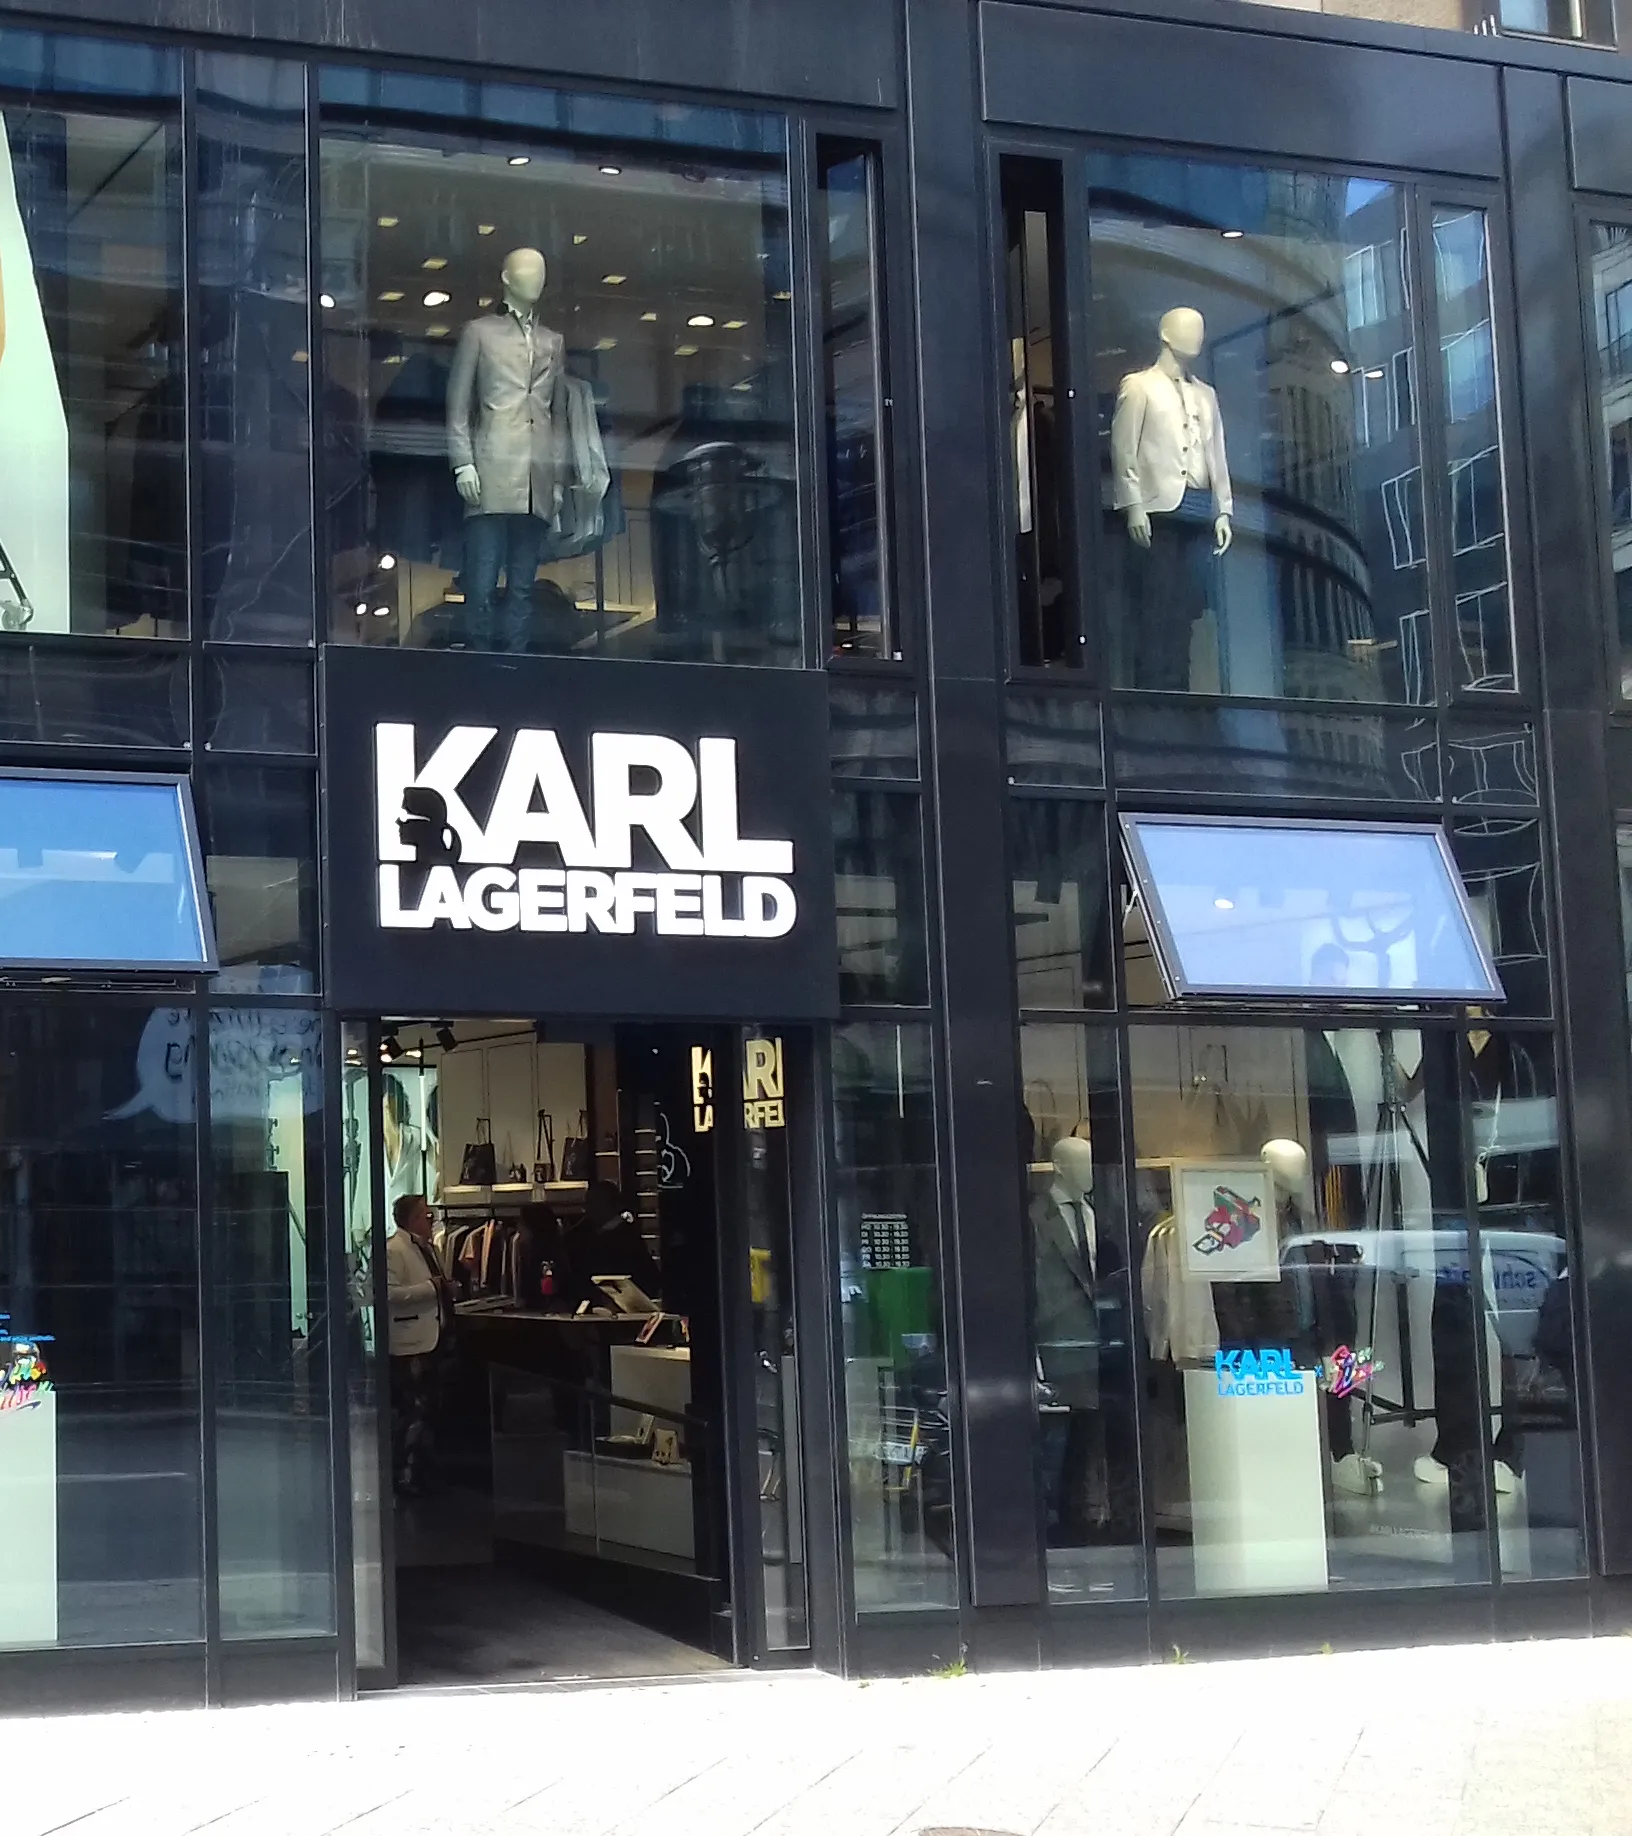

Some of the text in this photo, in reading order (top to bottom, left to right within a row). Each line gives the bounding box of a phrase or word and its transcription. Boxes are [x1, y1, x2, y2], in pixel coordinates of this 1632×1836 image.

[375, 722, 795, 873] KARL
[378, 864, 798, 938] LAGERFELD
[1215, 1348, 1303, 1381] KARL
[1217, 1381, 1304, 1397] LAGERFELD
